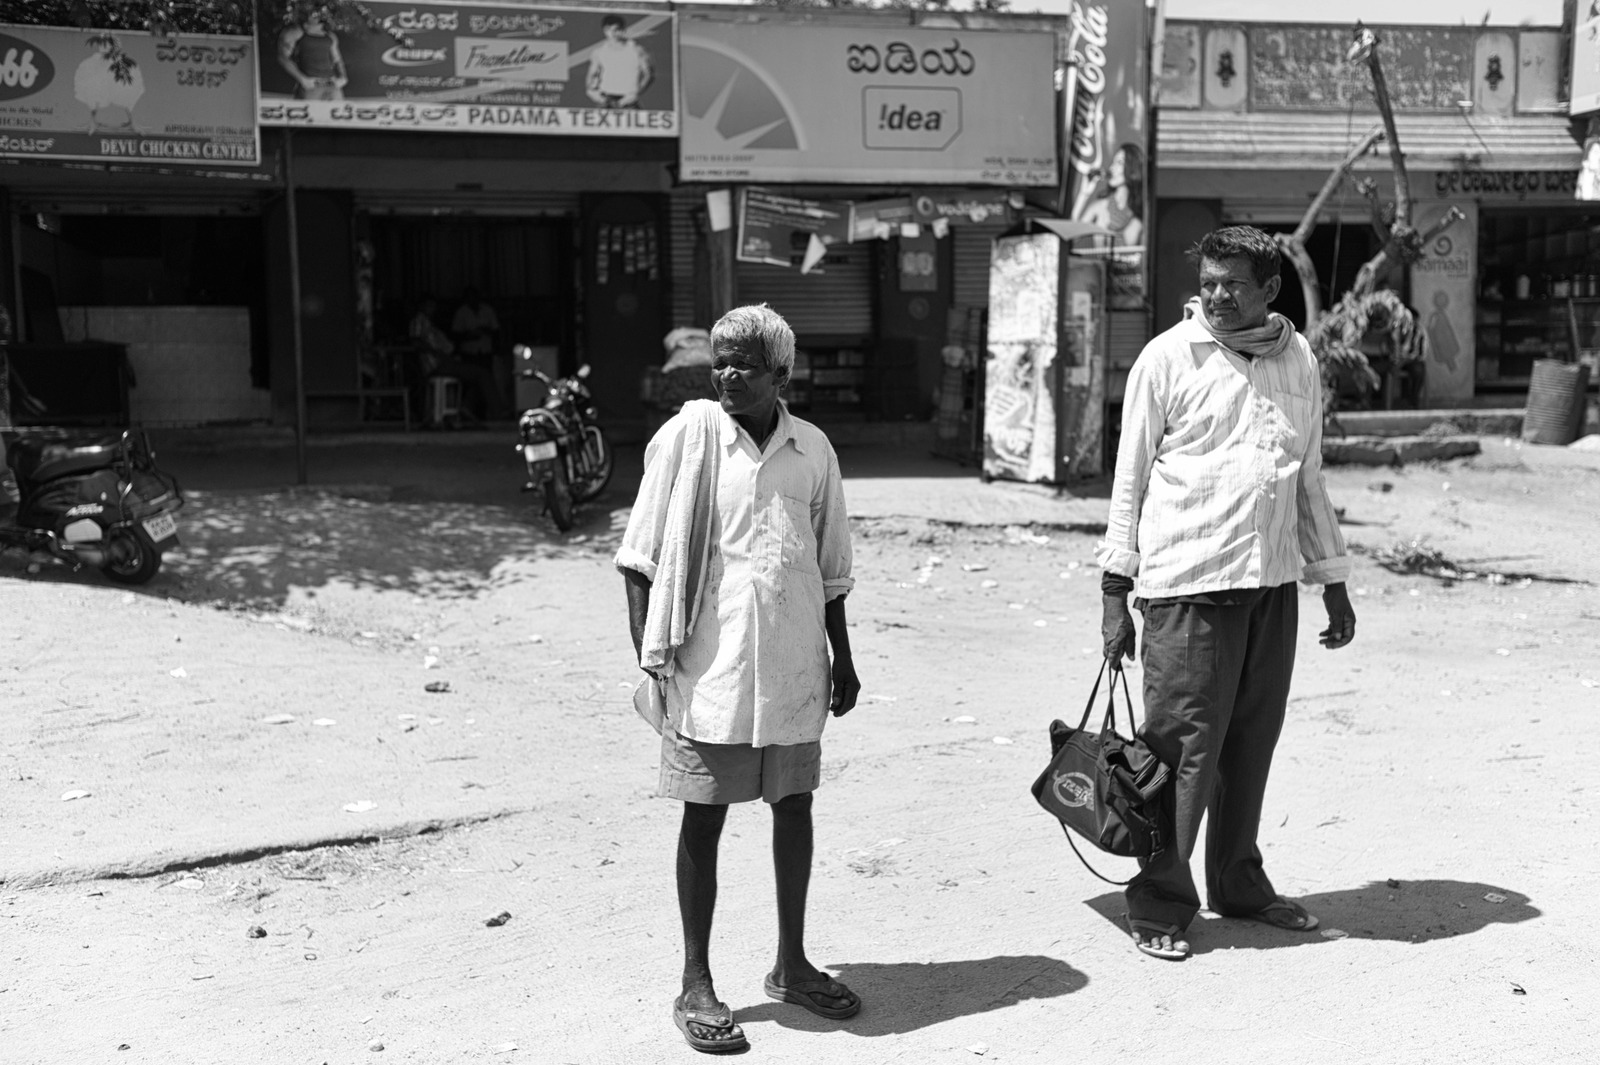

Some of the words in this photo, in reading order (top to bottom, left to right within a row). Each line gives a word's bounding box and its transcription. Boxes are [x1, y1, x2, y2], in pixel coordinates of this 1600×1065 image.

[465, 44, 559, 70] Frontline
[468, 106, 561, 127] PADAMA
[570, 109, 673, 130] TEXTILES
[100, 138, 138, 156] DEVU
[139, 140, 200, 158] CHICKEN
[202, 142, 255, 160] CENTRE
[936, 200, 1004, 216] vodafne
